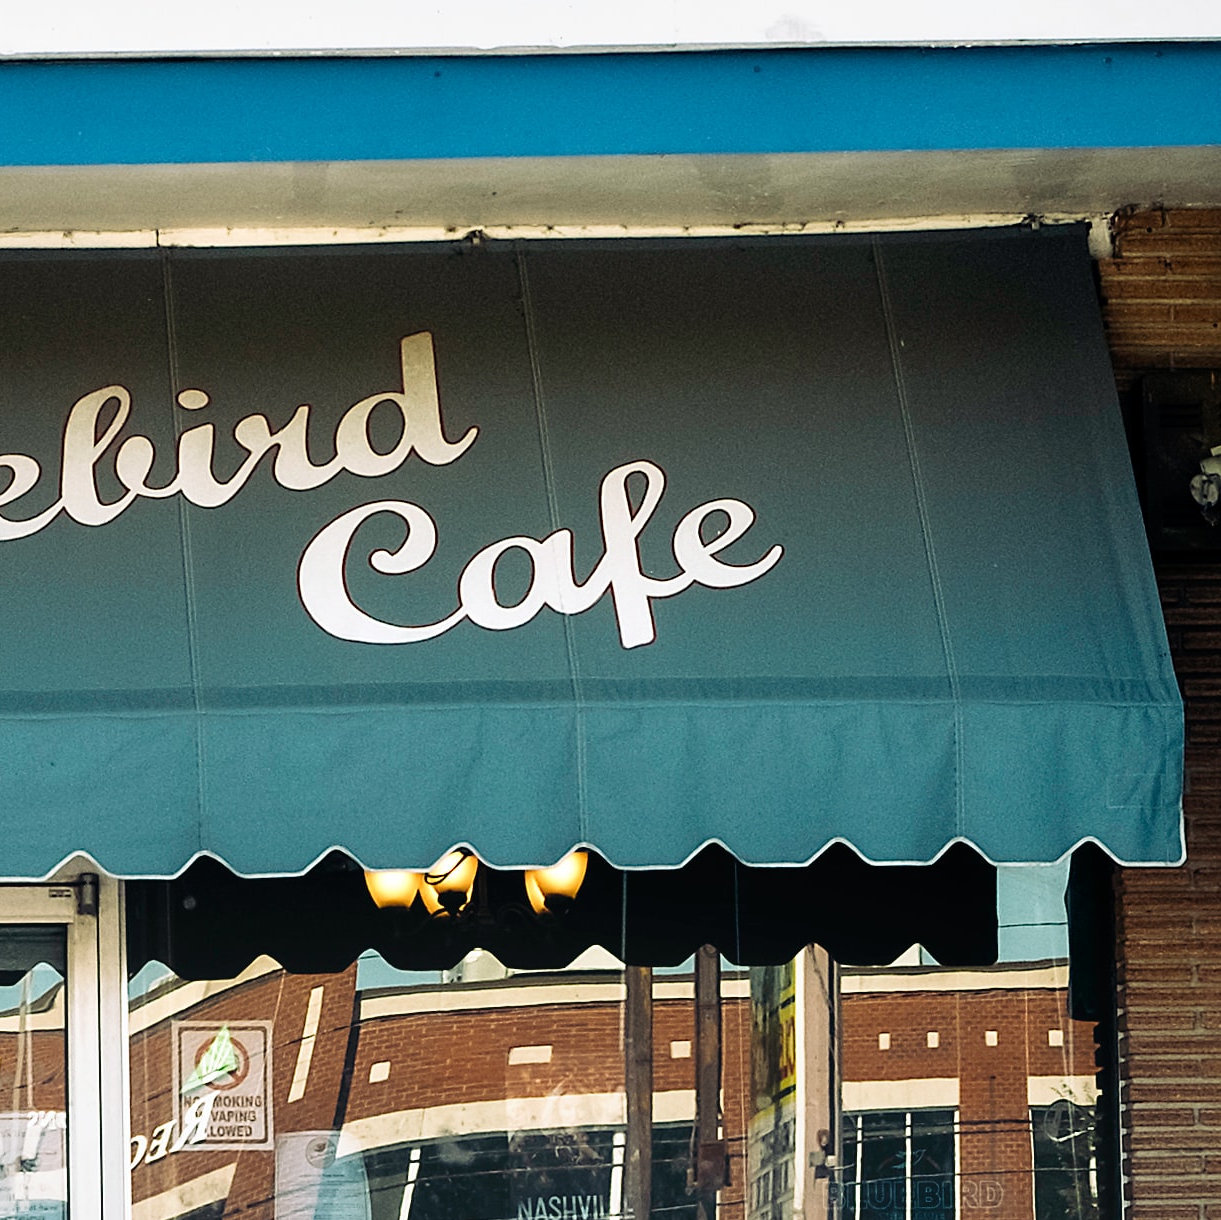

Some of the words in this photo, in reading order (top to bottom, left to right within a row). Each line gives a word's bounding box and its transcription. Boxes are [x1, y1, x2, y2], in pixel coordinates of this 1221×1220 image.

[297, 459, 783, 649] Cafe
[213, 1096, 262, 1107] MOKING
[211, 1111, 257, 1122] VAPING
